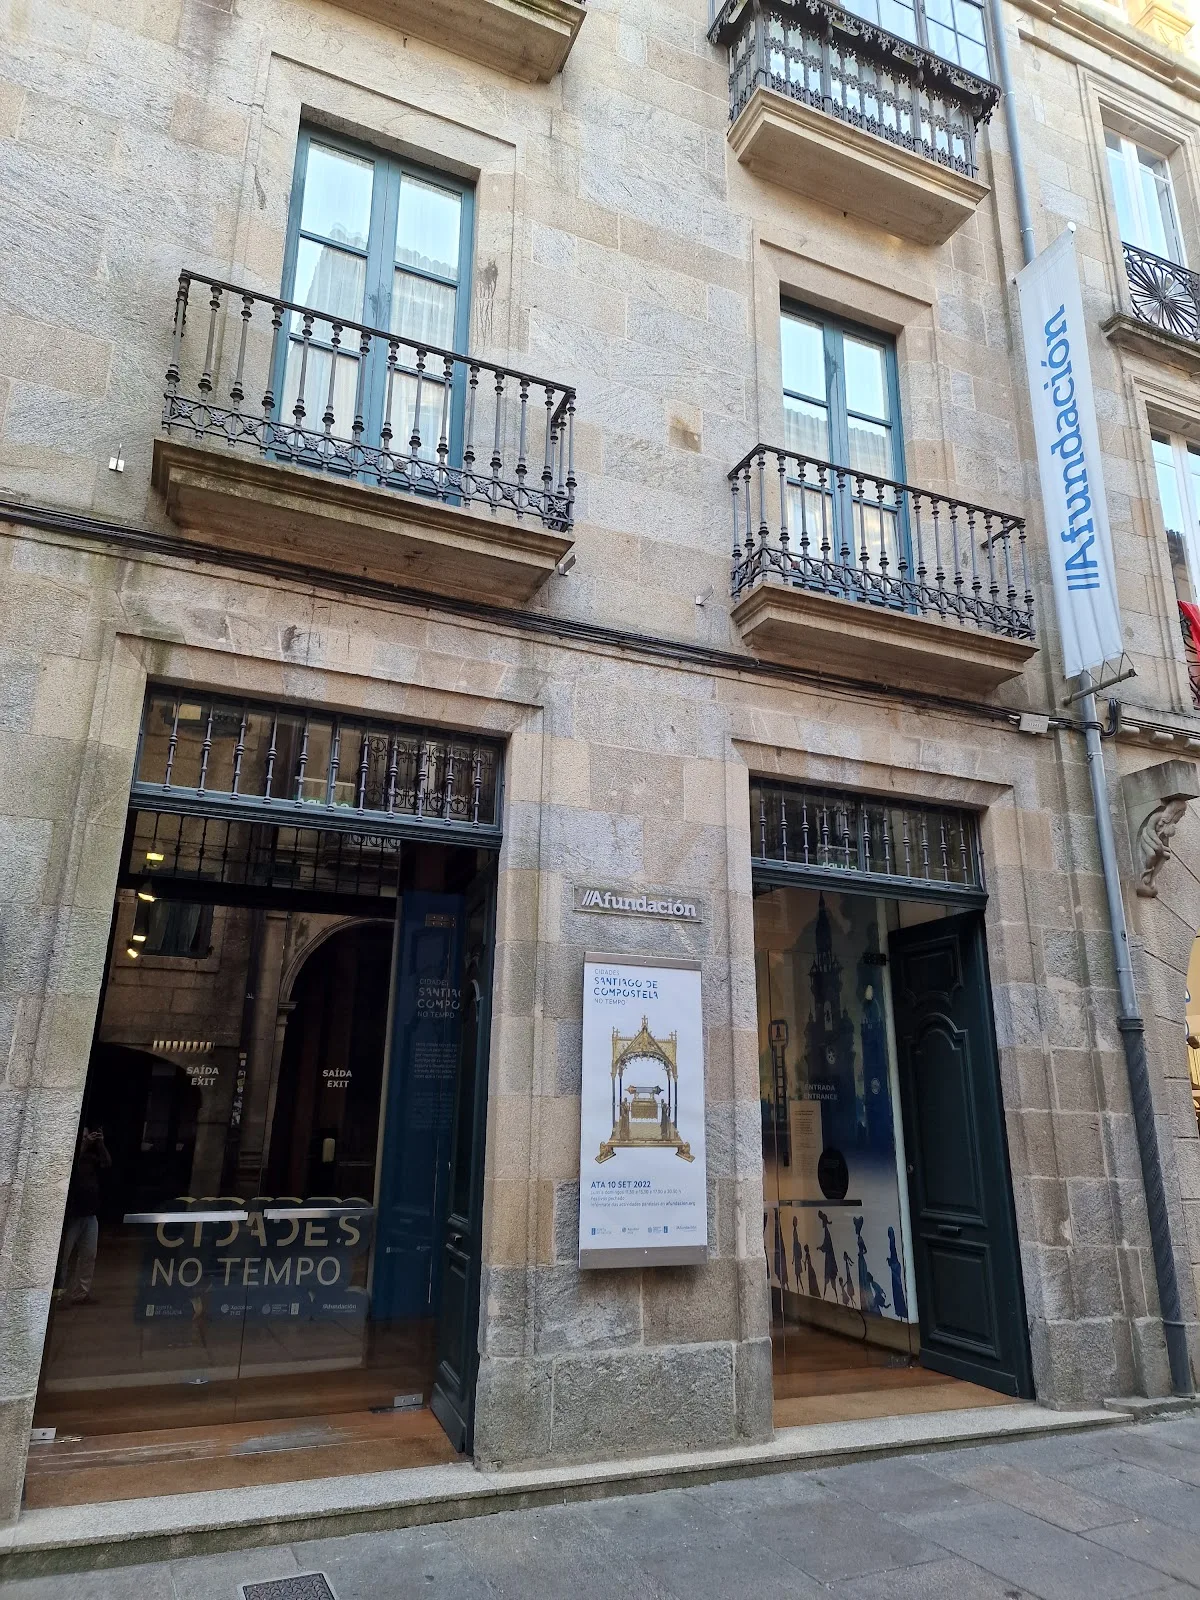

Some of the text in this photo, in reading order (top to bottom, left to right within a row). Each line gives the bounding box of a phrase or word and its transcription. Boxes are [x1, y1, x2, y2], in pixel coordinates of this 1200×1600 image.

[594, 968, 620, 976] CIDADES
[594, 976, 658, 989] SANTIAGO DE
[593, 987, 659, 1000] COMPOSTELA
[594, 997, 626, 1006] NO TEMPO
[417, 1010, 455, 1019] NO TEMPO
[186, 1065, 220, 1076] SAÍDA
[322, 1068, 353, 1078] SAÍDA
[191, 1077, 216, 1087] EXIT
[326, 1080, 350, 1088] EXIT
[804, 1083, 836, 1091] ENTRADA
[803, 1092, 838, 1100] ENTRANCE
[590, 1180, 651, 1189] ATA 10 SET 2022
[156, 1212, 361, 1249] CIDADES
[151, 1256, 341, 1288] NO TEMPO
